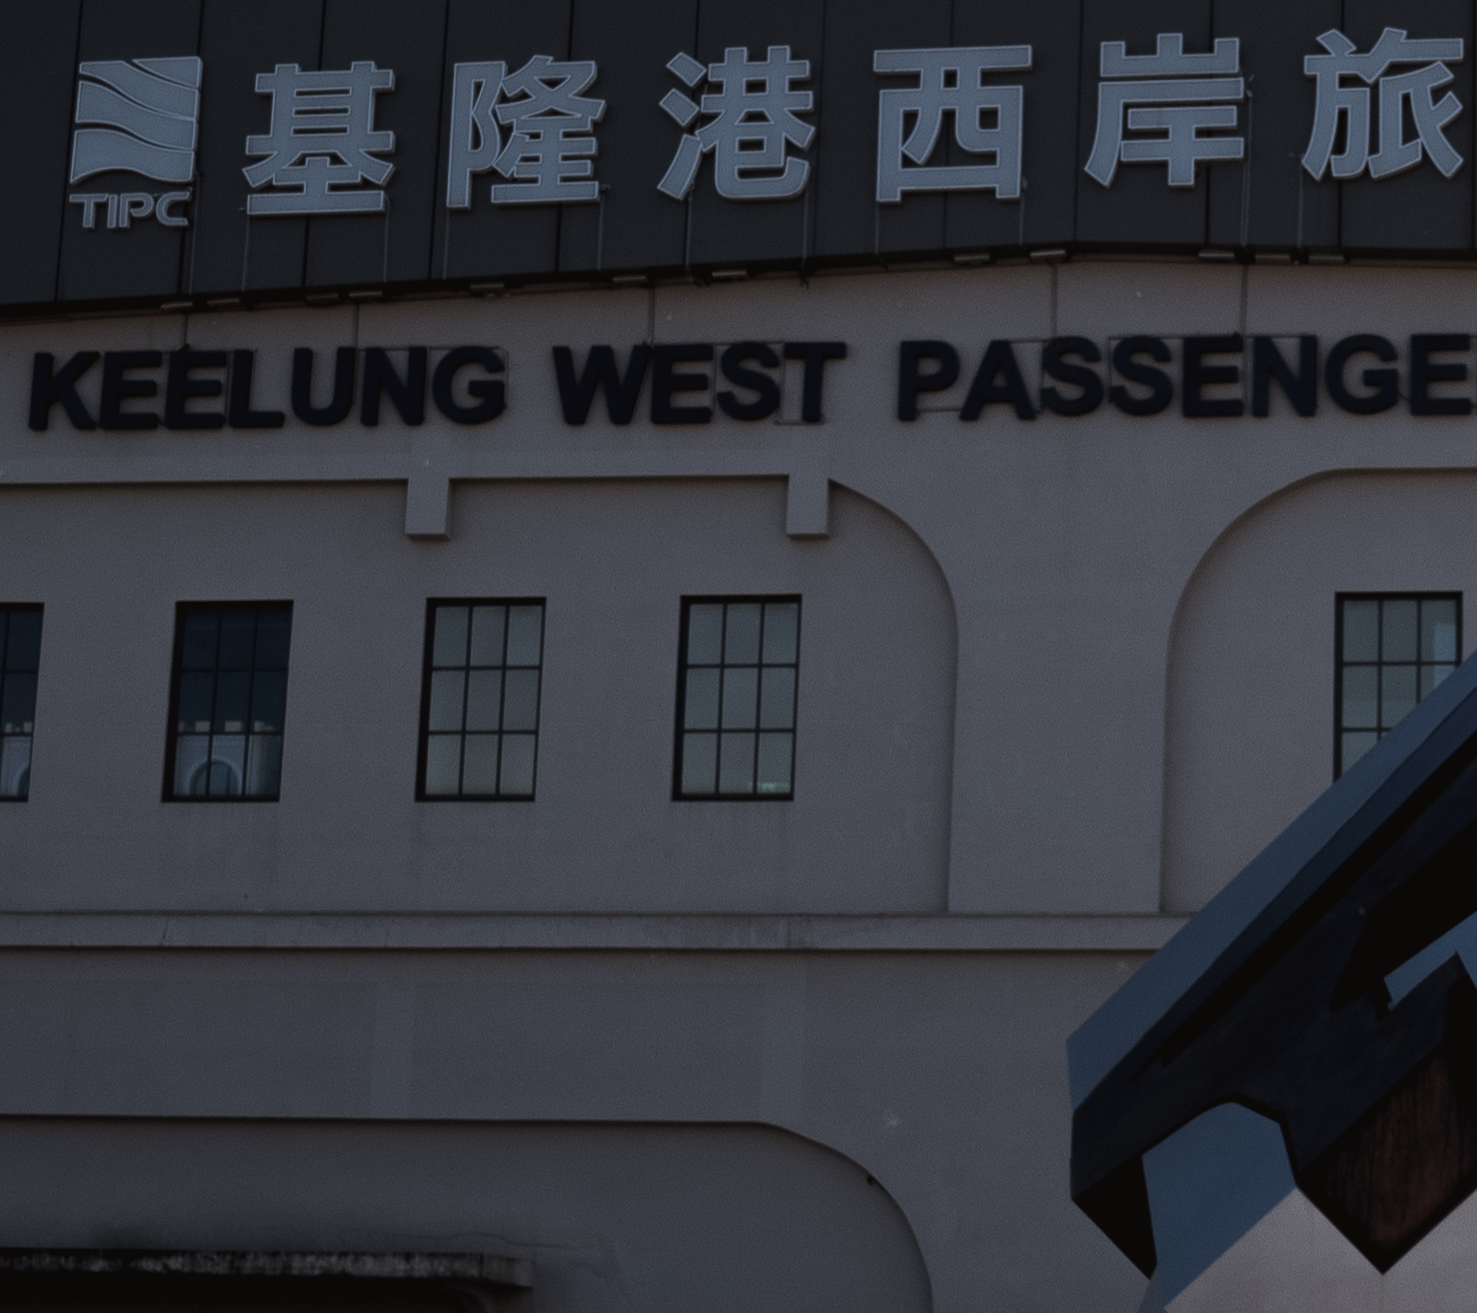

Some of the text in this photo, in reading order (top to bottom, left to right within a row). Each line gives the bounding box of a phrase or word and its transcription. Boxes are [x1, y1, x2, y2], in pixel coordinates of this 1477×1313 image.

[69, 190, 194, 229] TIPC
[27, 343, 507, 431] KEELUNG
[552, 339, 847, 426] WEST
